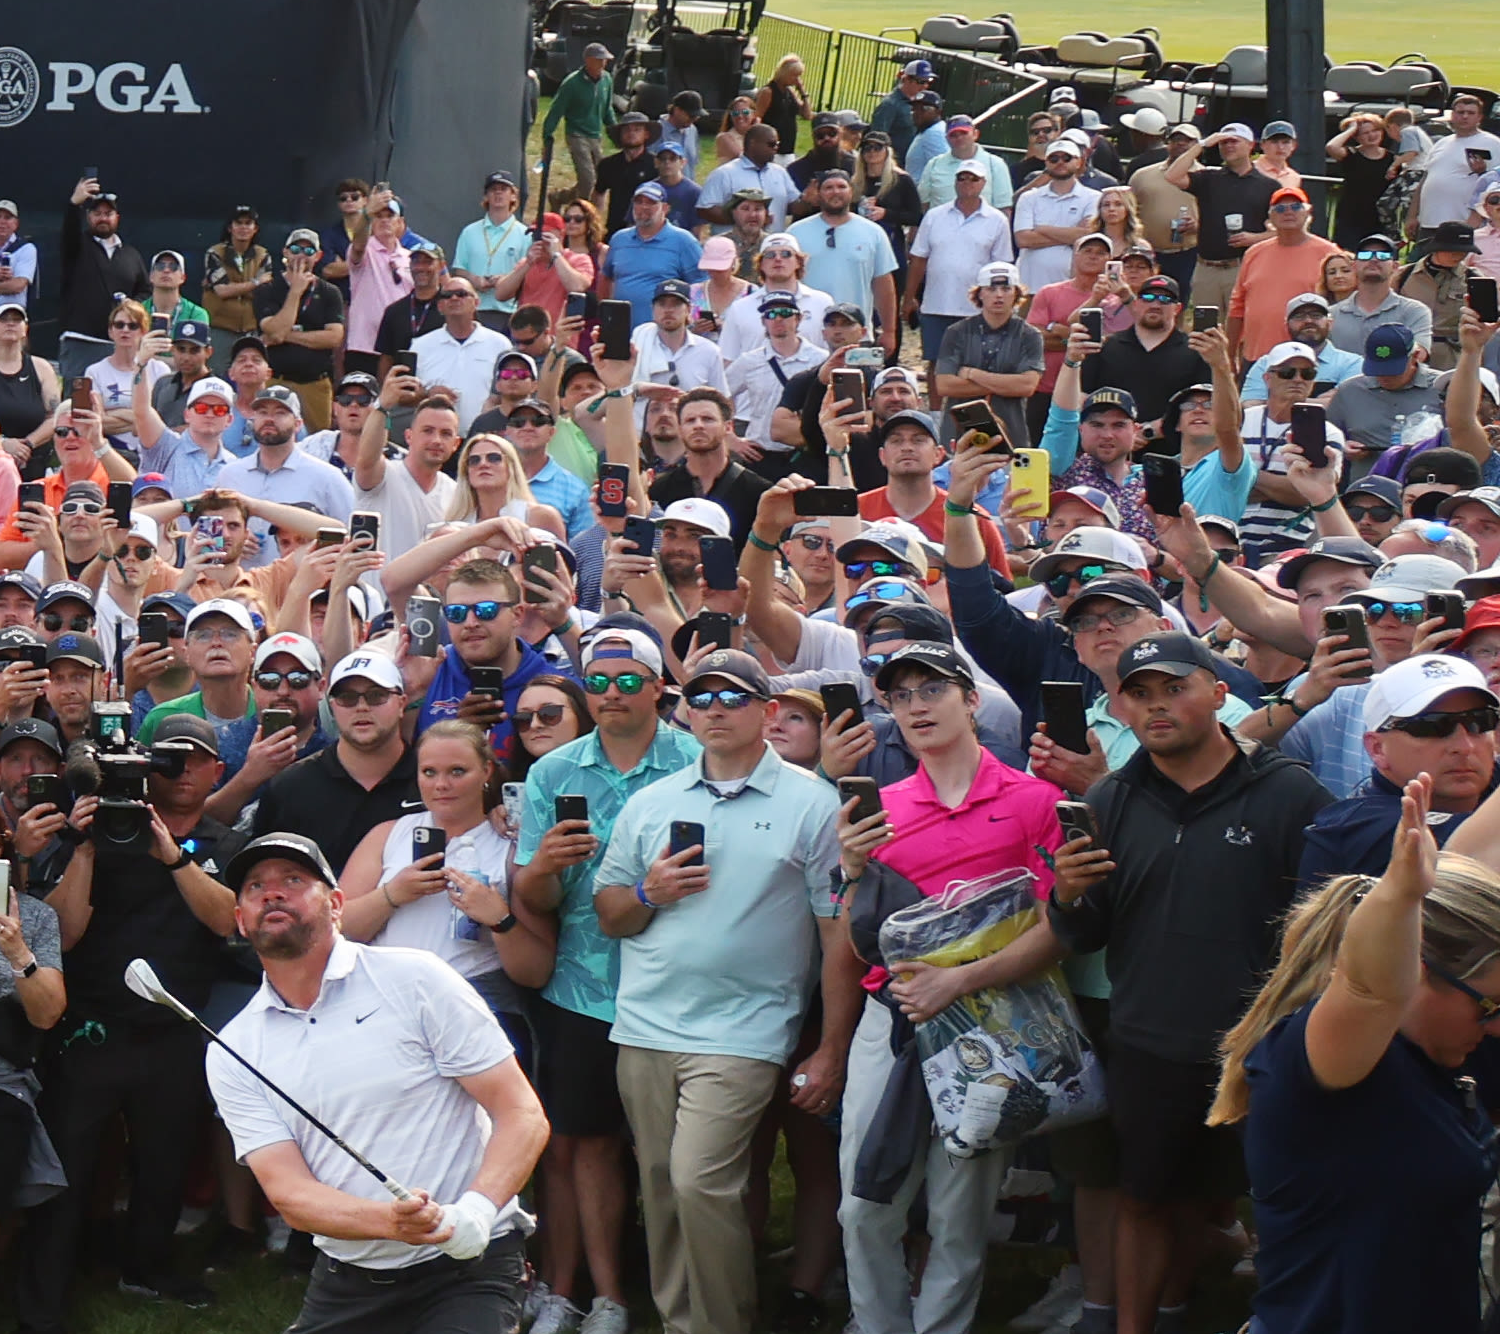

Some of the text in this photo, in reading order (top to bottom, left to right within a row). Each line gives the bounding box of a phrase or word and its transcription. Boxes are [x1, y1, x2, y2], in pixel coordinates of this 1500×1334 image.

[45, 61, 203, 114] PGA
[1092, 391, 1122, 406] HILL
[602, 478, 624, 504] S
